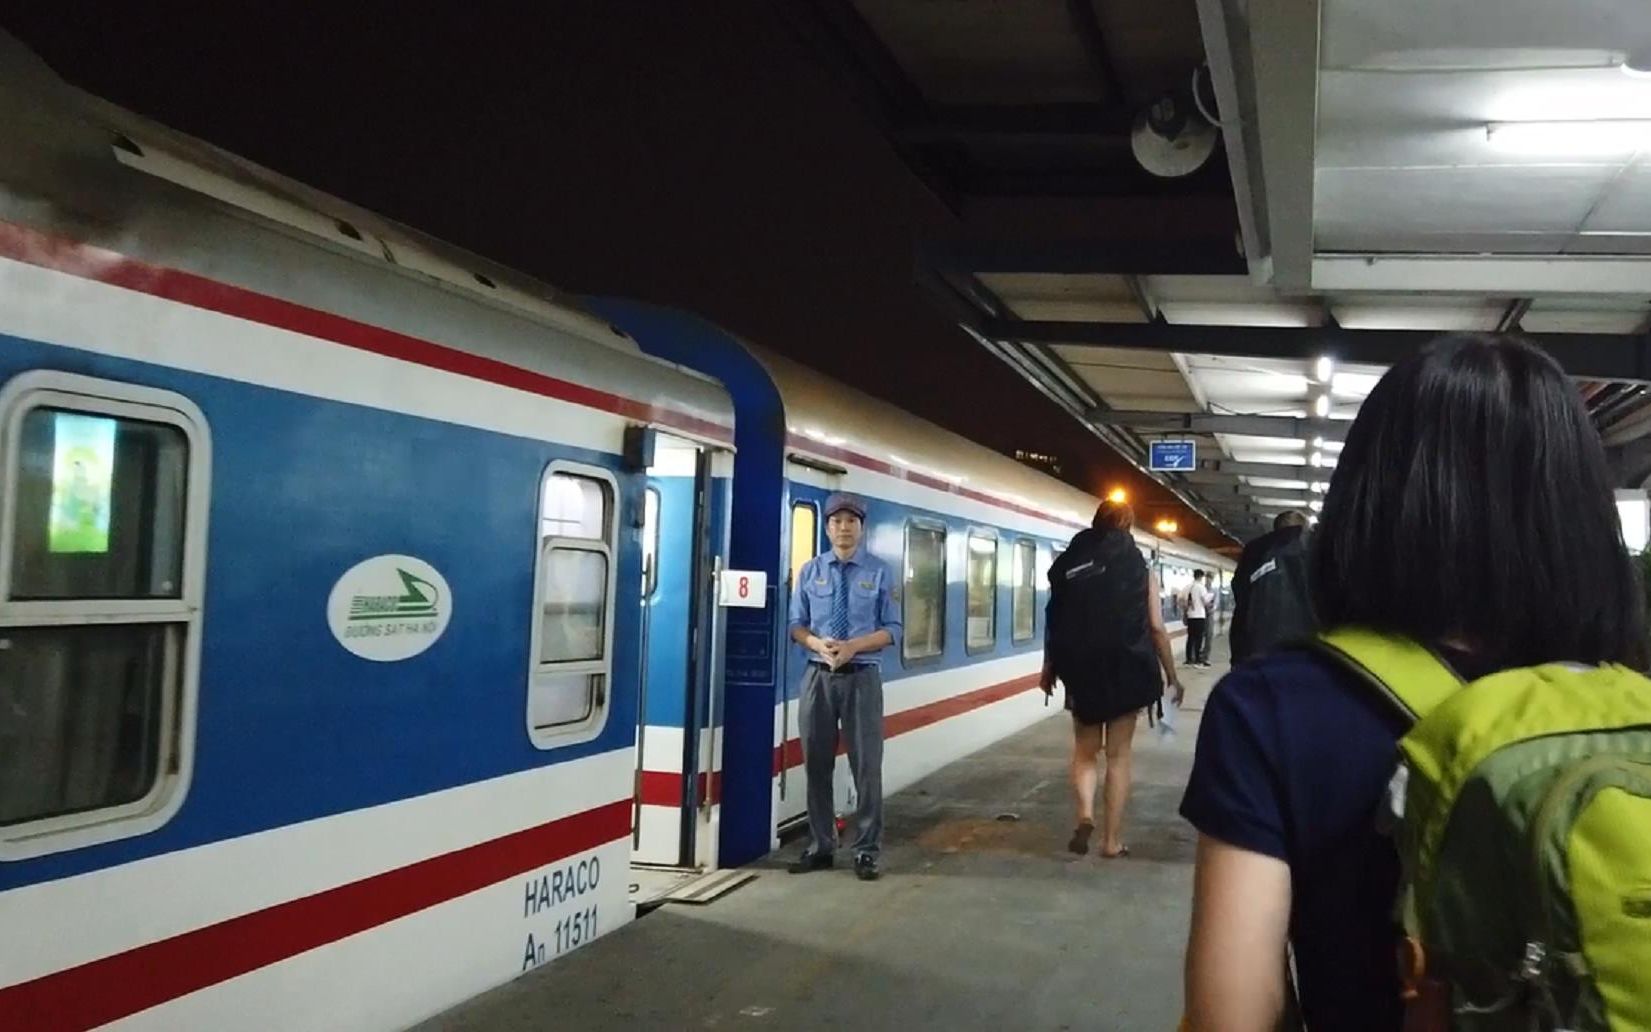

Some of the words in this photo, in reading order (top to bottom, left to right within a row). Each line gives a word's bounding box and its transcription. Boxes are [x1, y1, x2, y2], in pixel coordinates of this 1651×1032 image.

[738, 576, 749, 599] 8
[524, 855, 600, 918] HARACO
[554, 903, 598, 954] 11511
